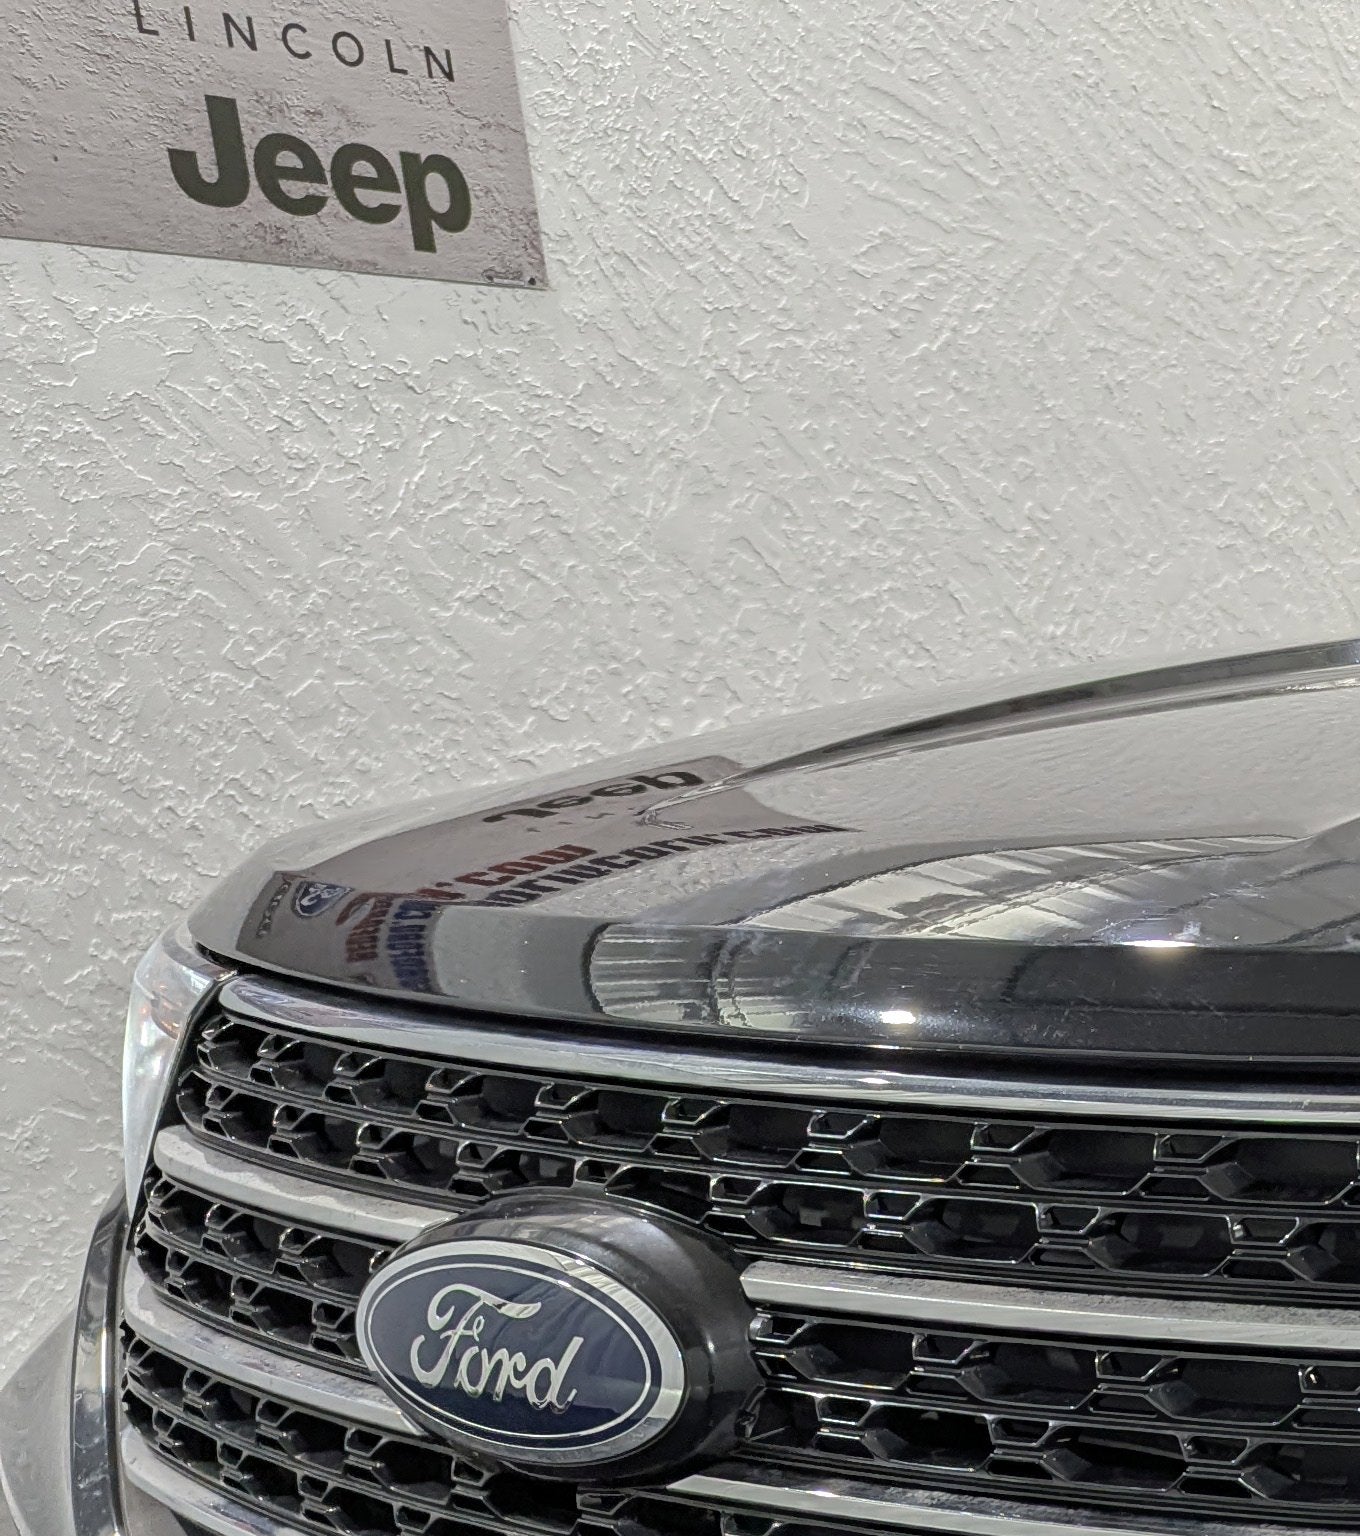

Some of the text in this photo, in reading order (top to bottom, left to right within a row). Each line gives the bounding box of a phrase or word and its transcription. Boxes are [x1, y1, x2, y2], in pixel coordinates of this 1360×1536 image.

[132, 0, 455, 83] LINCOLN
[168, 95, 471, 254] Jeep
[410, 1283, 585, 1415] Ford
